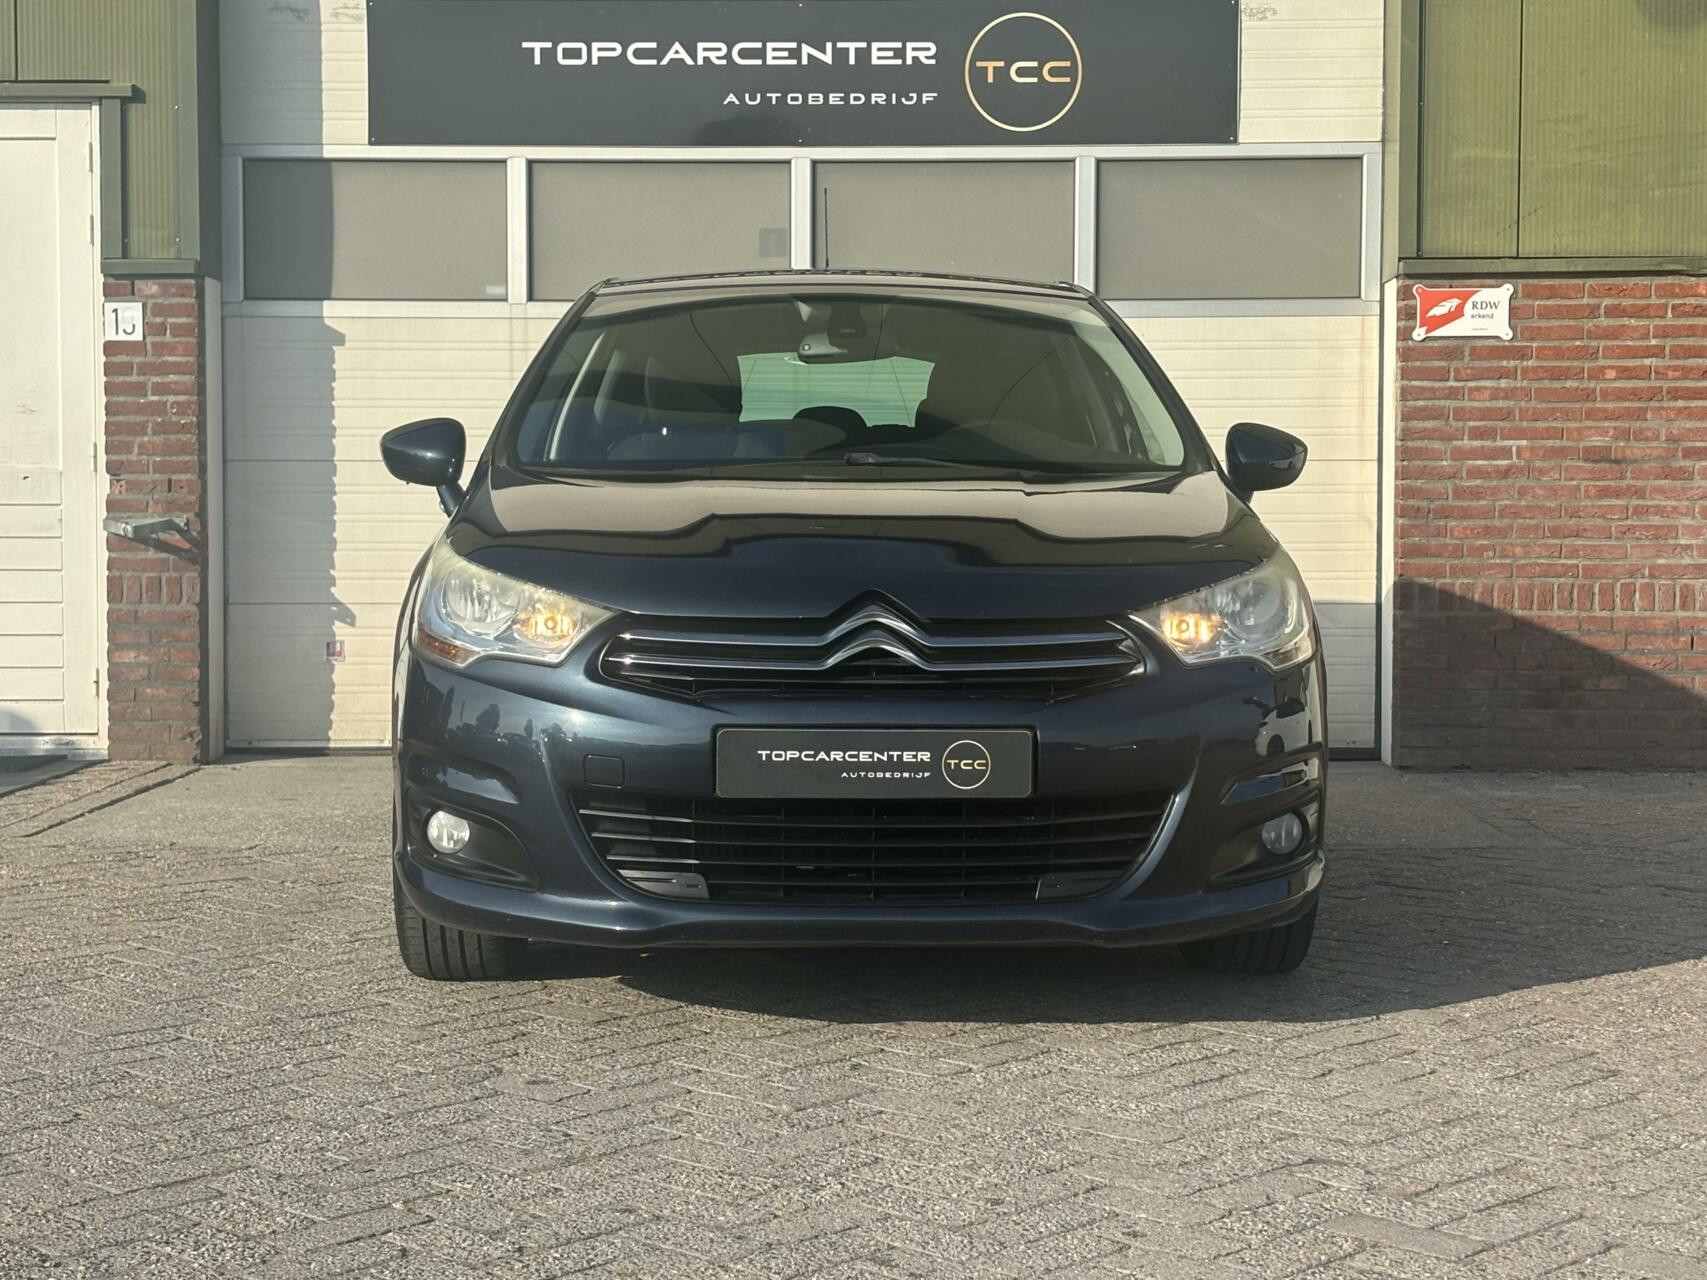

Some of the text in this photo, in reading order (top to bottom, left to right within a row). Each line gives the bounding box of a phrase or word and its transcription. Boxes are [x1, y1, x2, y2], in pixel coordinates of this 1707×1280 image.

[521, 41, 938, 66] TOPCARCENTER
[975, 60, 1072, 84] TCC
[722, 92, 939, 106] AUTOBEDRIJF
[1471, 300, 1501, 310] RDW
[756, 750, 932, 762] TOPCARCENTER
[946, 759, 988, 770] TCC
